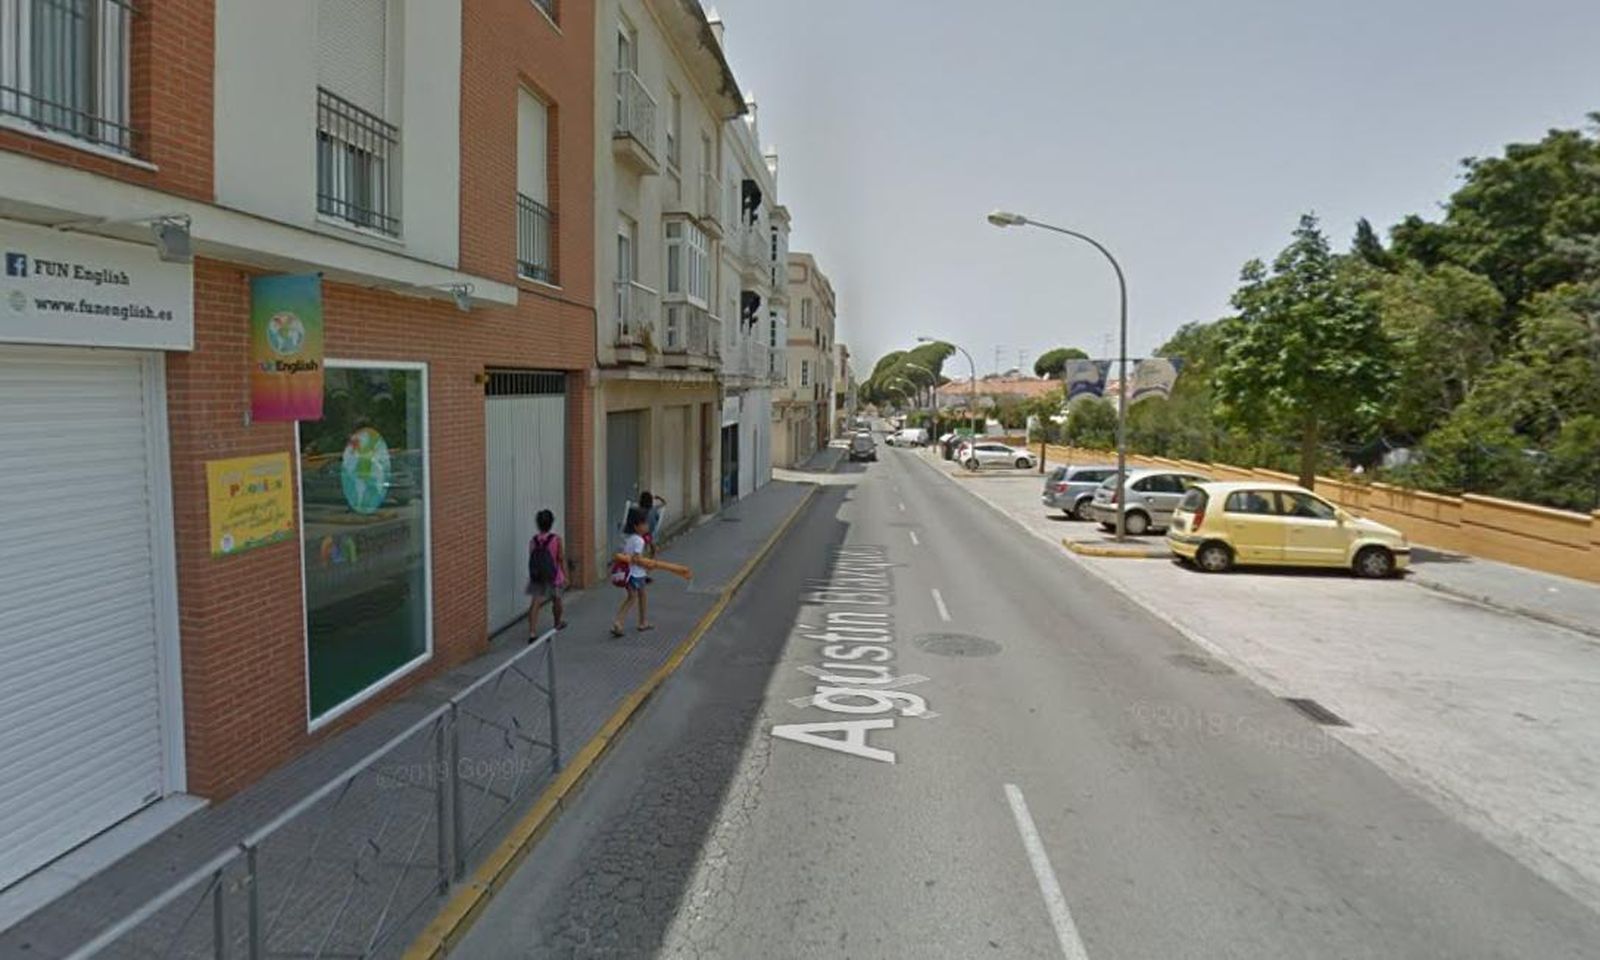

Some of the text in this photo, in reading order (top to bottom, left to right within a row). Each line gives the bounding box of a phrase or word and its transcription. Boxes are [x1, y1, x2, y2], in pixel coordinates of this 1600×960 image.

[34, 259, 69, 279] FUN
[73, 265, 130, 286] English
[34, 298, 174, 321] www.funenglish.es
